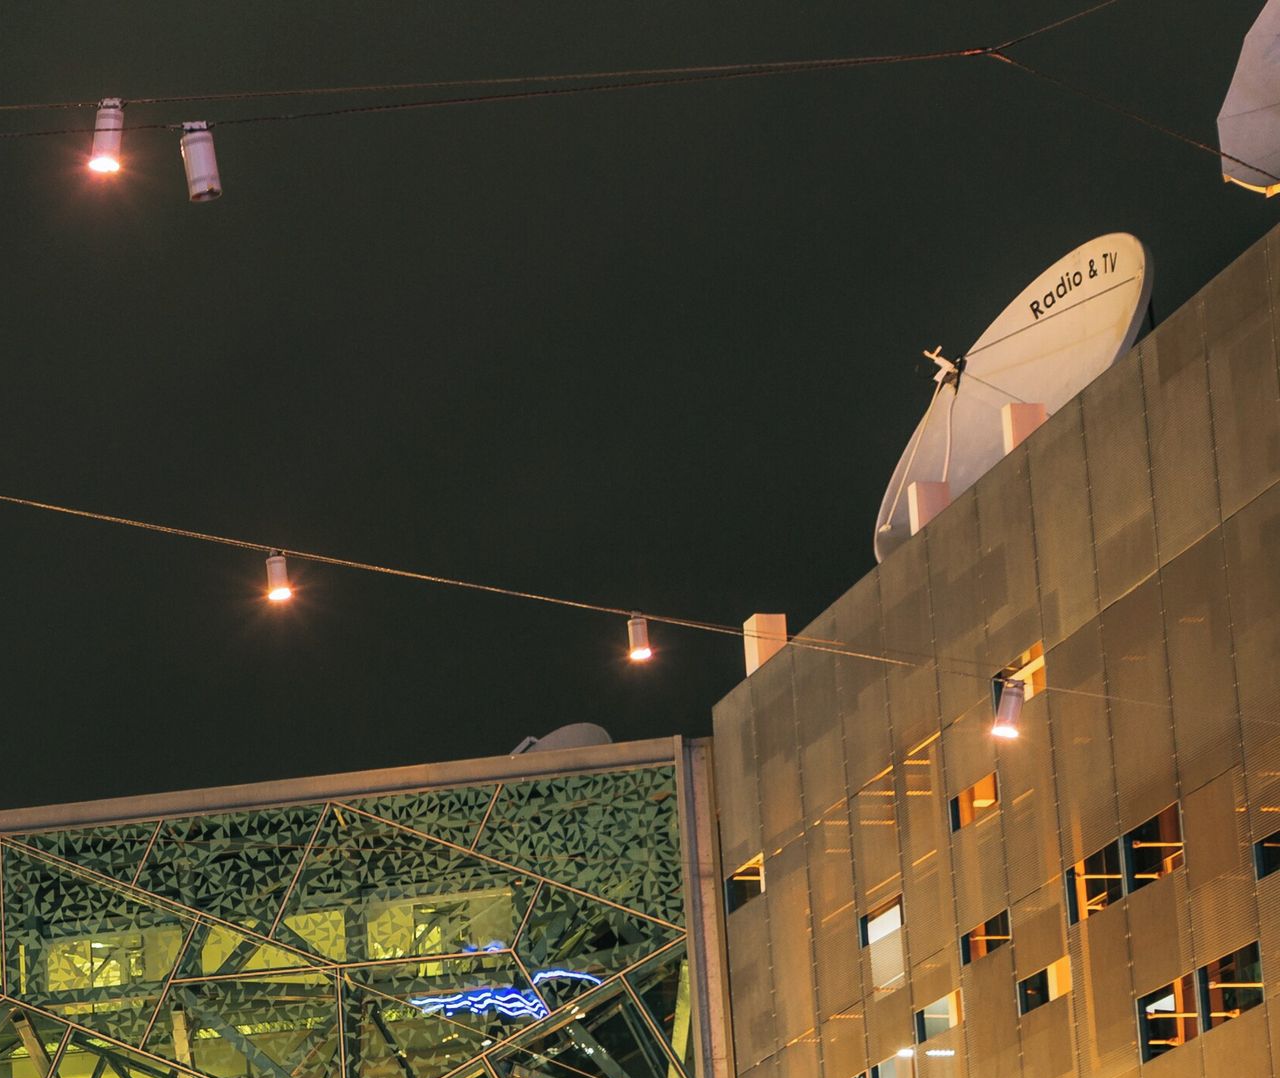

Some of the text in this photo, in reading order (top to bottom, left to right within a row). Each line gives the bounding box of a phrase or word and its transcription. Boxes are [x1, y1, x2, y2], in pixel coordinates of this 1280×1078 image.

[1030, 252, 1117, 319] Radio & TV
